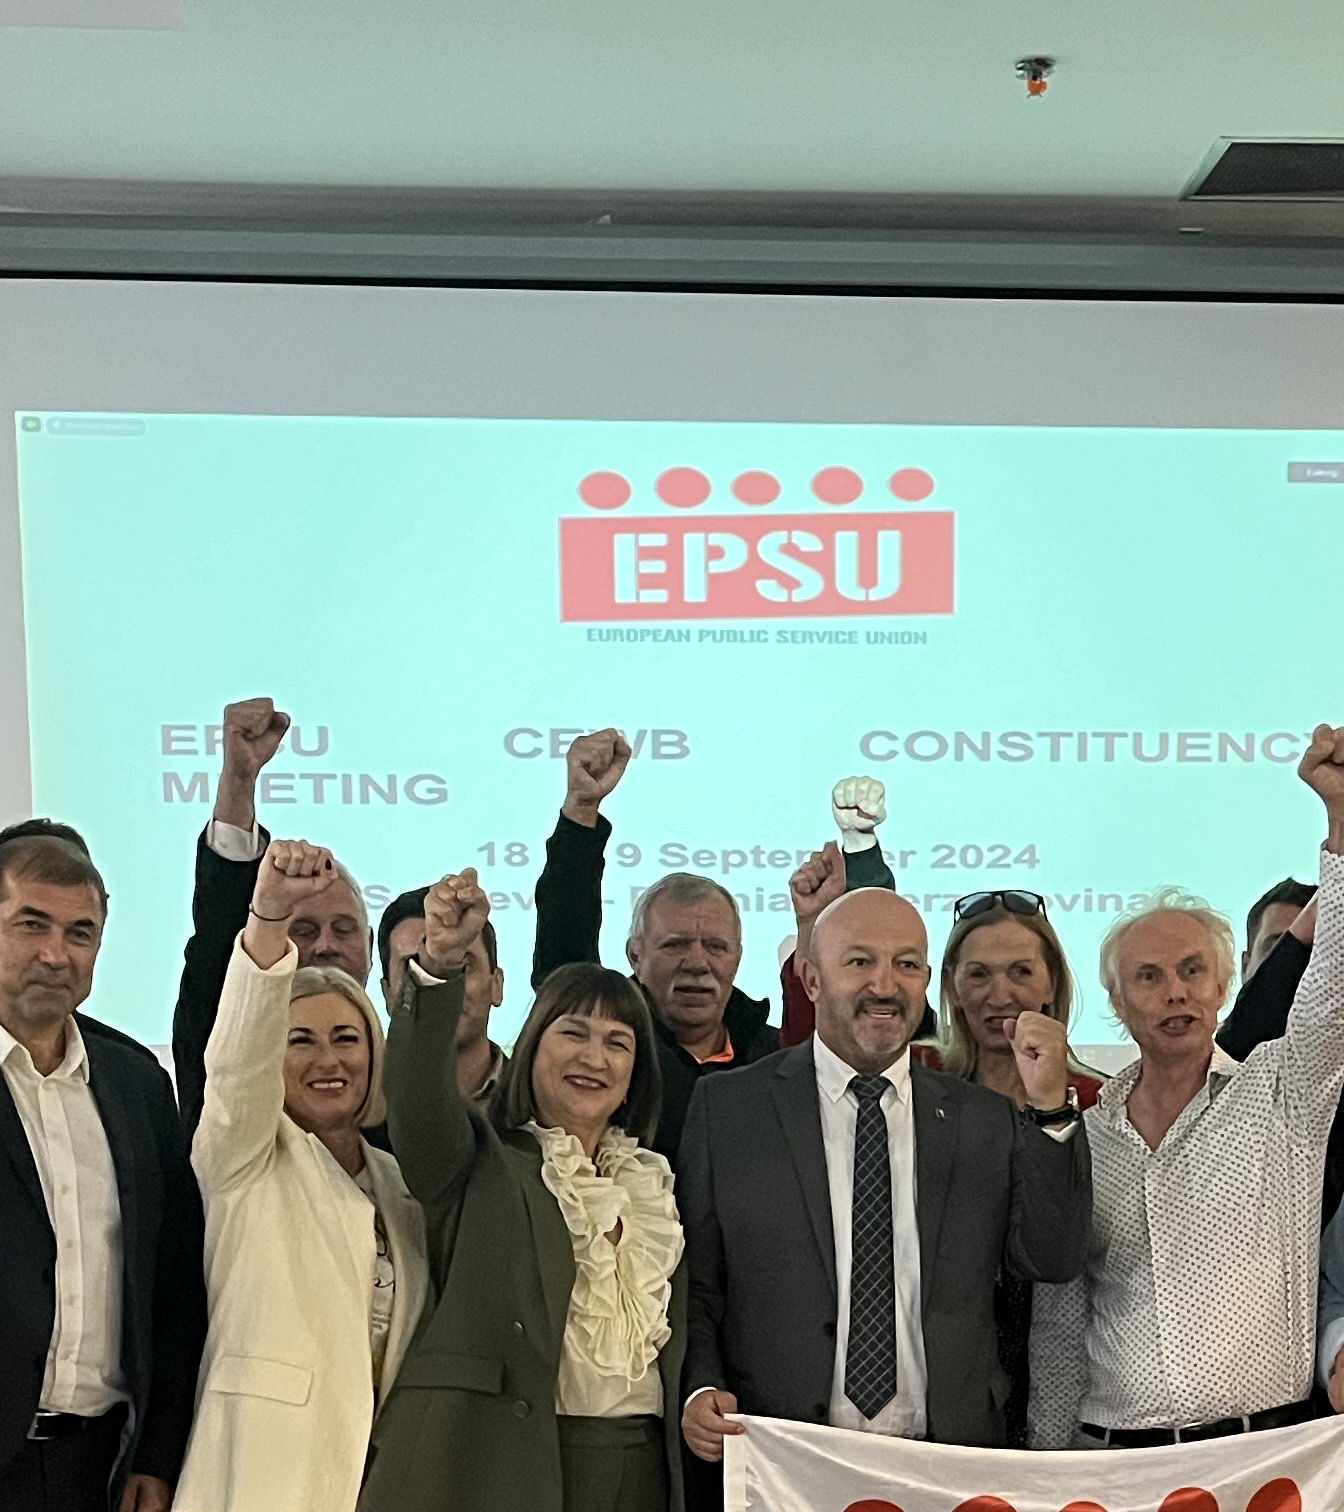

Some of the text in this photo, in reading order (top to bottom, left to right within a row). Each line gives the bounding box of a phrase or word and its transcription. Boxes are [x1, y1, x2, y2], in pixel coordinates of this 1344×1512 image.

[614, 530, 902, 603] EPSU
[586, 628, 928, 645] EUROPEAN PUBLIC SERVICE UNION
[161, 724, 1314, 764] EPU CEB CONSTITUENC
[162, 771, 448, 805] METING
[476, 841, 529, 867] 18
[930, 843, 1041, 870] 2024
